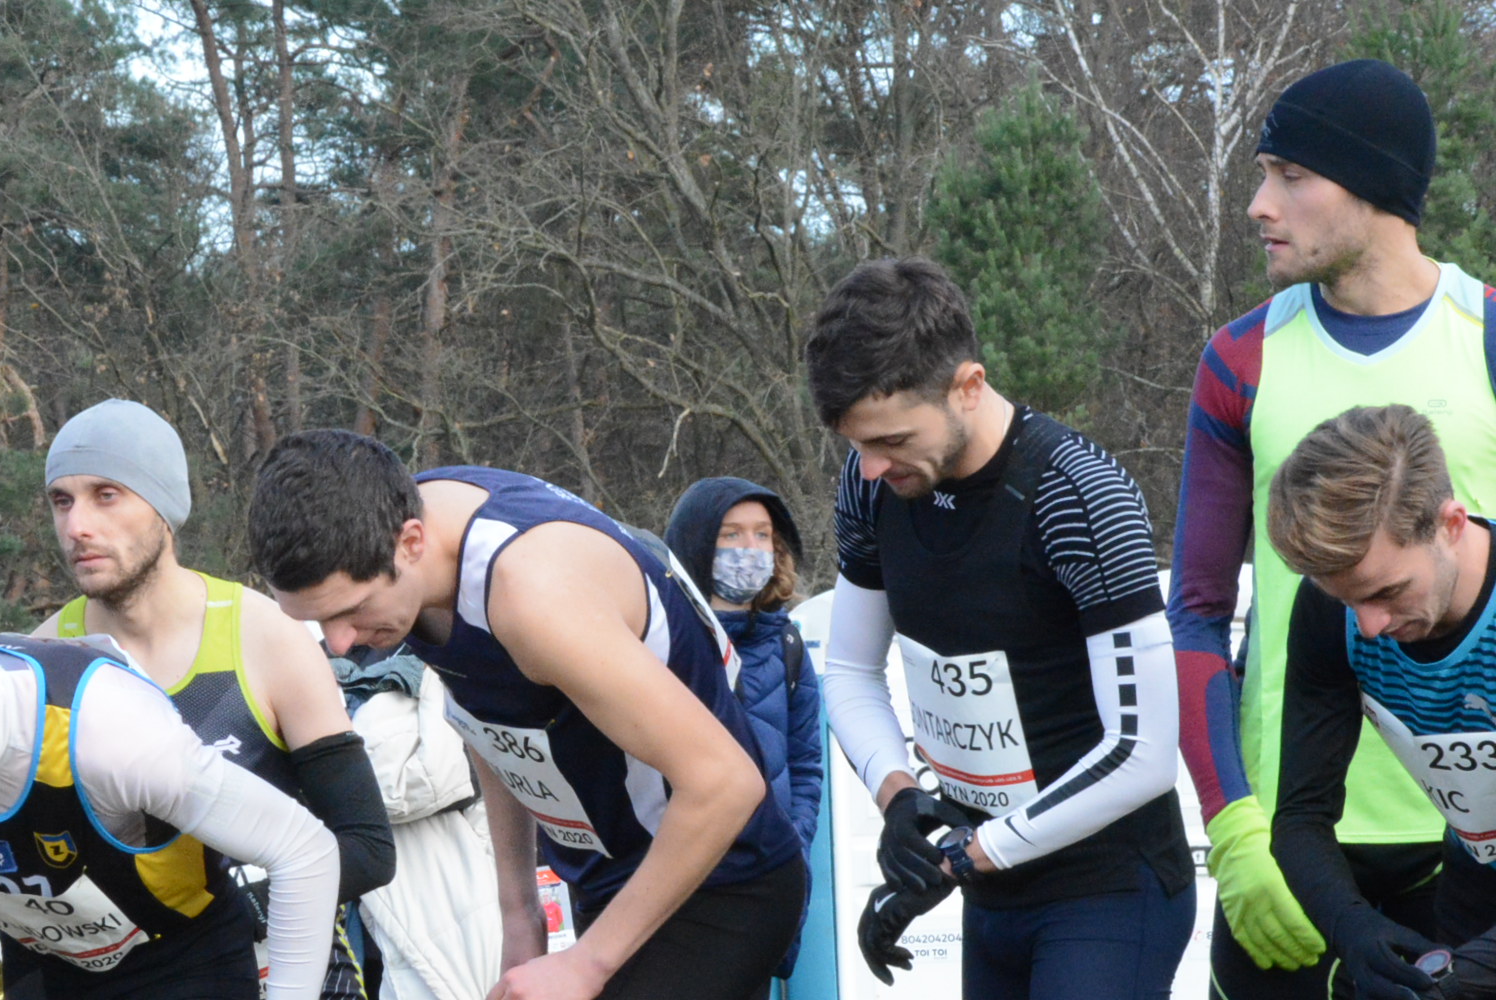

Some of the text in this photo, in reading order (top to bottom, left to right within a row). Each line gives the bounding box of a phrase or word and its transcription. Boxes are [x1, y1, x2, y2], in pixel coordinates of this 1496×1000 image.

[931, 660, 993, 697] 435
[483, 727, 545, 763] 386
[1421, 740, 1496, 771] 233
[498, 764, 560, 802] URLA
[970, 790, 1009, 807] 2020
[558, 829, 594, 845] 2020
[915, 948, 947, 957] TOI TOI
